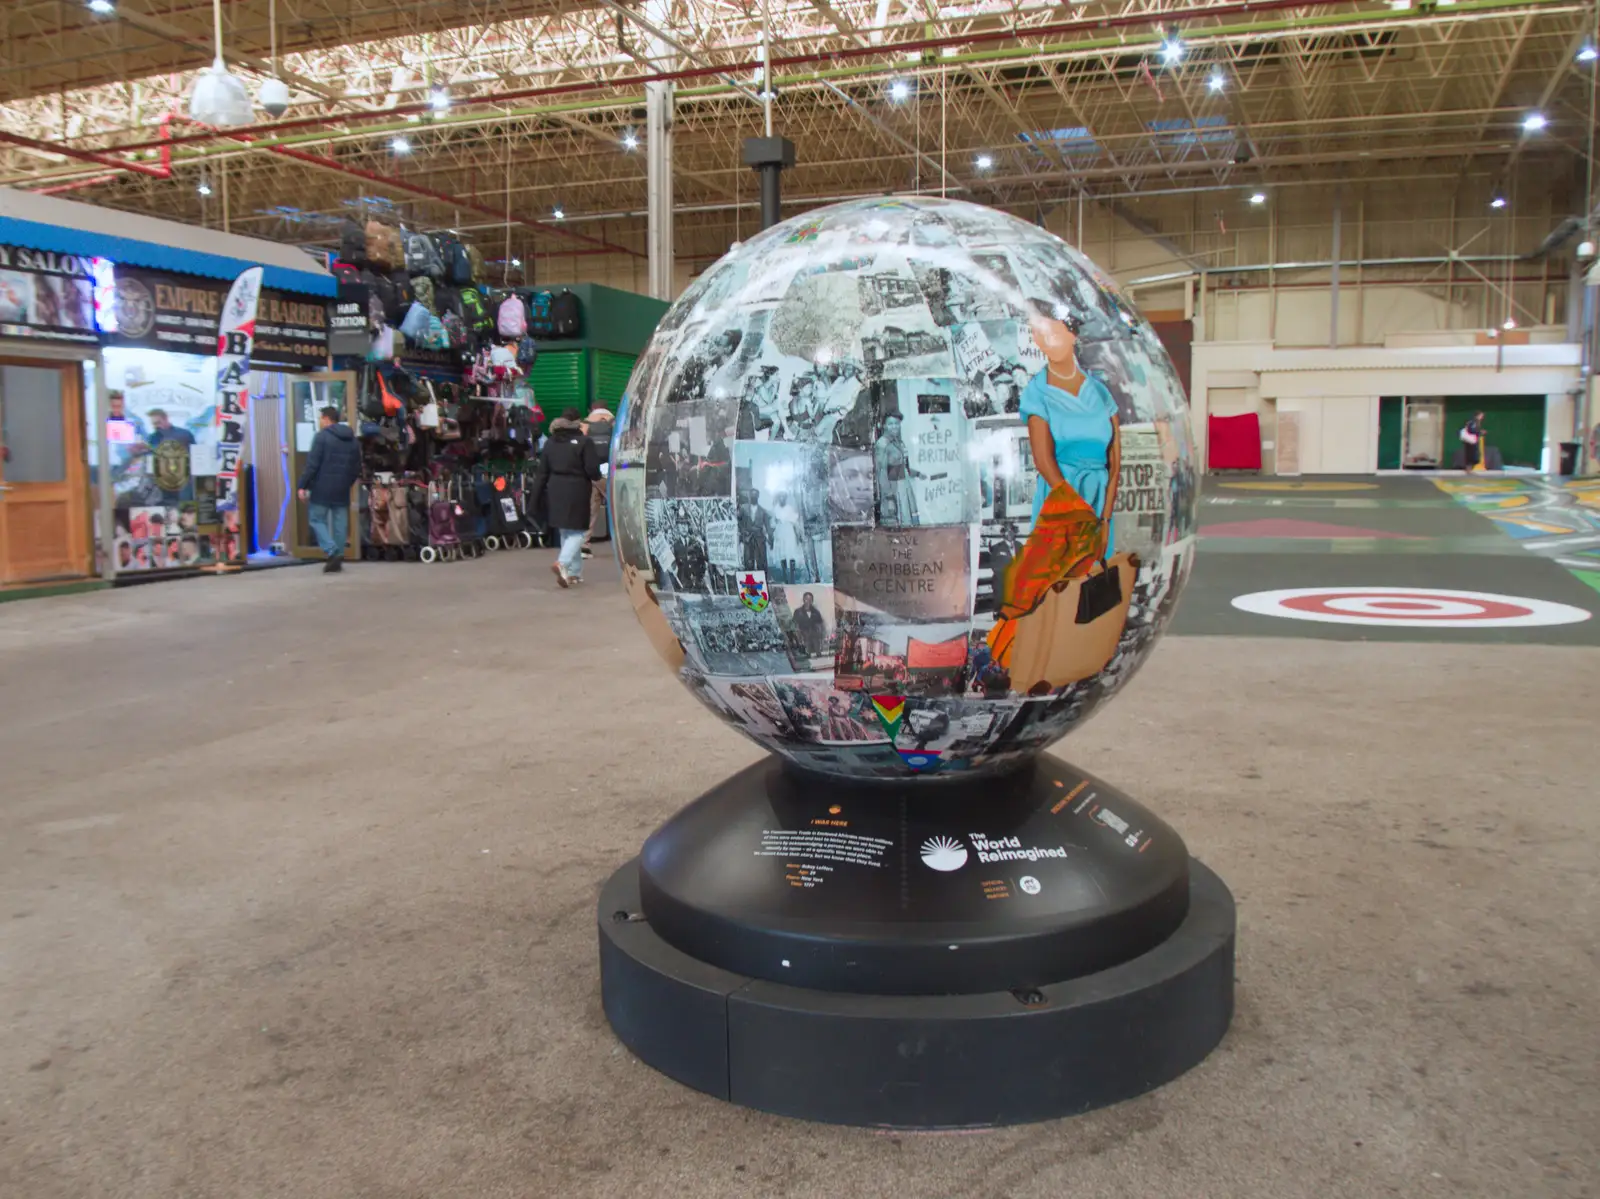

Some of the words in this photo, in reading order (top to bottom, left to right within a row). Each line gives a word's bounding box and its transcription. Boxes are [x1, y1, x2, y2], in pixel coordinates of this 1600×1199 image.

[154, 284, 219, 316] EMPIRE
[337, 302, 360, 314] HAIR
[270, 299, 326, 328] BARBER
[330, 315, 367, 328] STATION
[918, 428, 952, 445] KEEP
[891, 548, 913, 560] THE
[853, 560, 943, 576] CARIBBEAN
[873, 578, 936, 594] CENTRE
[968, 832, 986, 840] The
[972, 836, 1021, 851] World
[977, 845, 1067, 863] Reimagined
